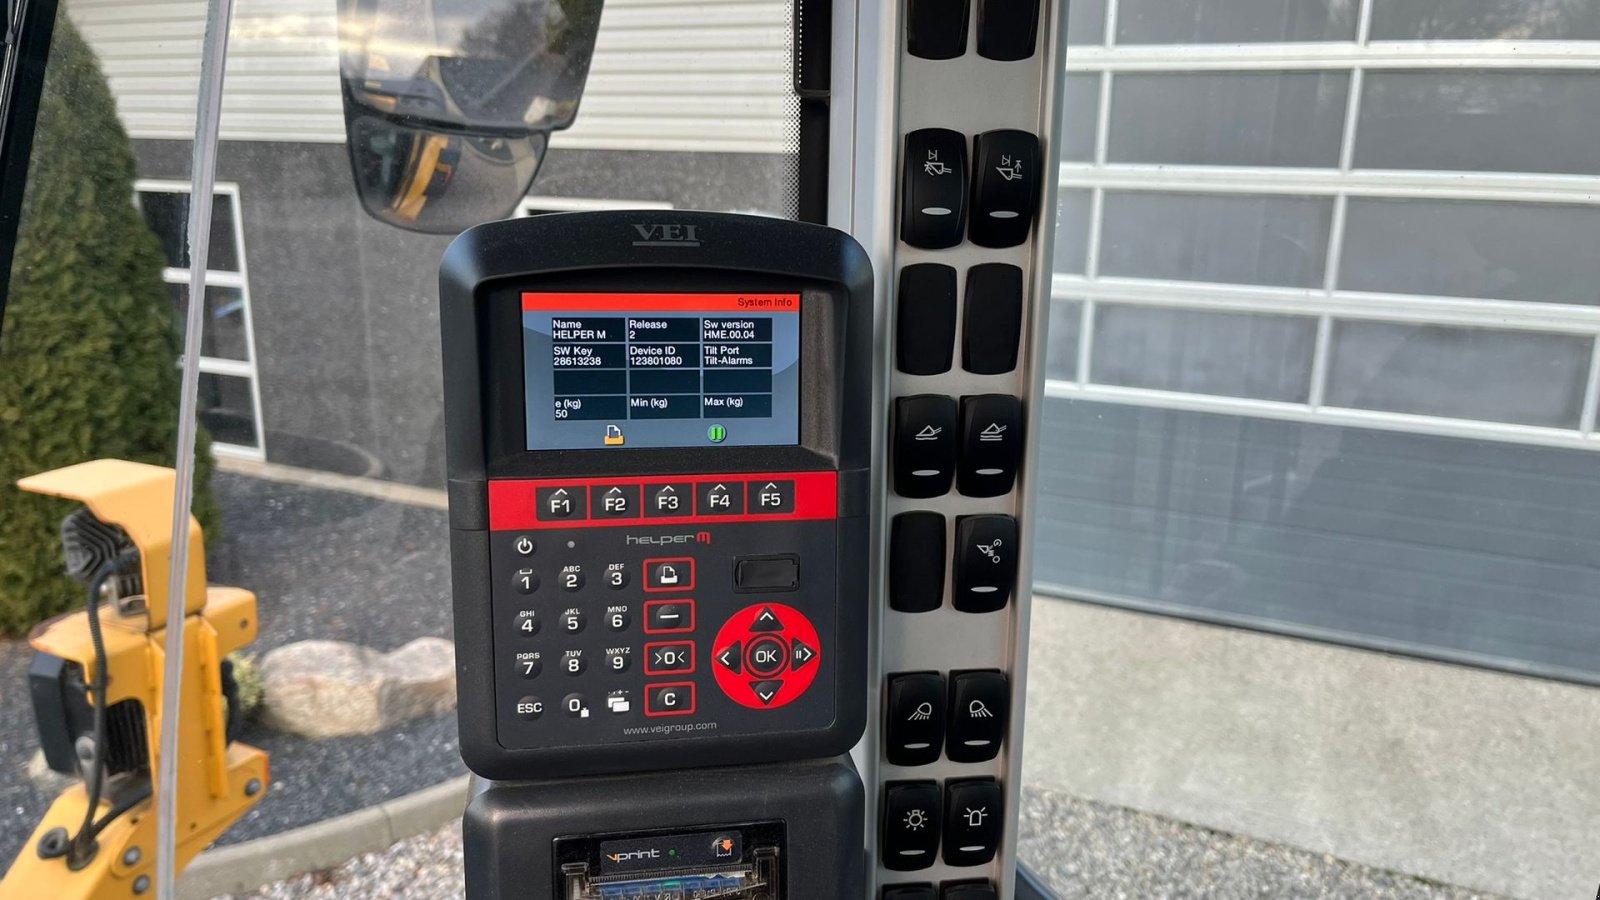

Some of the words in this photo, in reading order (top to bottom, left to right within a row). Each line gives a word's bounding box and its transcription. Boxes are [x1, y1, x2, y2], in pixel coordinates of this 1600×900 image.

[631, 224, 699, 240] VEI
[737, 297, 772, 308] System
[774, 297, 793, 307] Info
[553, 320, 582, 329] Name
[629, 320, 667, 329] Release
[704, 320, 717, 329] Sw
[721, 320, 754, 329] version
[553, 330, 595, 339] HELPER
[596, 330, 606, 339] M
[629, 330, 636, 339] 2
[704, 330, 755, 339] HME.00.04
[553, 346, 573, 356] SW
[575, 347, 593, 358] Key
[630, 346, 663, 356] Device
[665, 346, 676, 355] ID
[704, 346, 718, 355] Tilt
[720, 346, 739, 355] Port
[553, 357, 601, 366] 28613238
[630, 356, 682, 366] 123801080
[704, 356, 753, 365] Tilt-Alarms
[564, 398, 581, 410] (kg)
[630, 398, 649, 407] Min
[650, 398, 668, 409] (kg)
[704, 397, 725, 406] Max
[726, 397, 743, 408] (kg)
[555, 410, 568, 418] 50
[551, 499, 571, 513] F1
[605, 498, 626, 512] F2
[658, 496, 679, 510] F3
[710, 495, 731, 508] F4
[761, 493, 781, 507] F5
[563, 565, 581, 573] ABC
[608, 563, 625, 571] DEF
[520, 576, 530, 589] 1
[566, 574, 578, 588] 2
[611, 572, 623, 586] 3
[520, 610, 535, 618] GHI
[607, 605, 628, 613] MNO
[521, 619, 534, 632] 4
[567, 617, 579, 630] 5
[612, 615, 623, 628] 6
[516, 652, 540, 660] PQRS
[606, 647, 631, 655] WXYZ
[755, 650, 777, 664] OK
[523, 661, 534, 675] 7
[568, 659, 580, 672] 8
[612, 656, 624, 669] 9
[568, 698, 581, 712] 0
[664, 693, 677, 706] C
[517, 702, 543, 714] ESC
[623, 720, 717, 736] www.veigroup.com
[606, 848, 660, 863] vprint
